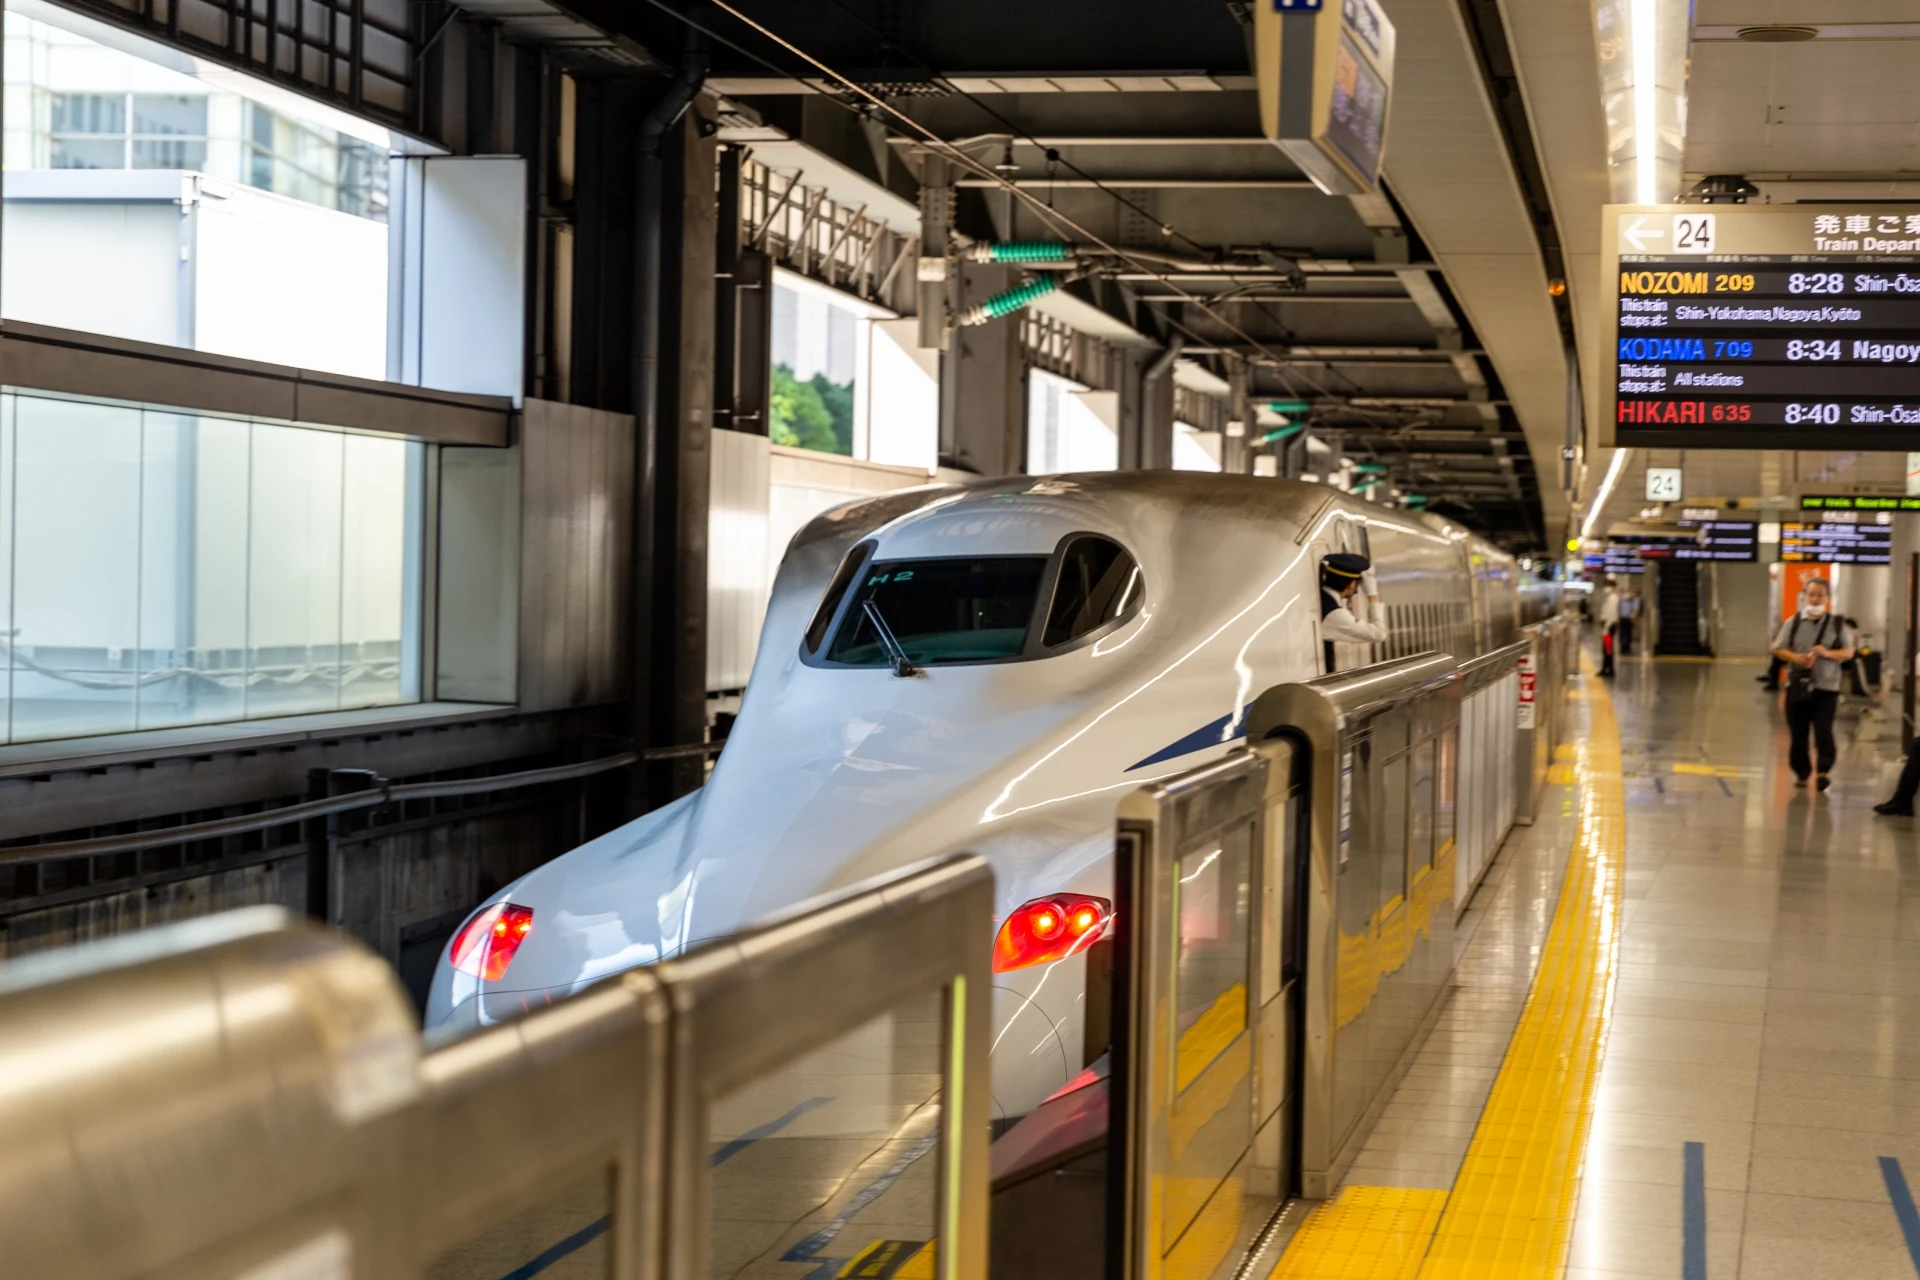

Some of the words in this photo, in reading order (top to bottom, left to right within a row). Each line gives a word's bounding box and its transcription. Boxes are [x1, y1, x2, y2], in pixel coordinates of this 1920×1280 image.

[1677, 219, 1711, 248] 24
[1813, 237, 1859, 251] Train
[1620, 271, 1709, 295] NOZOMI
[1715, 274, 1755, 292] 209
[1788, 272, 1845, 294] 8:28
[1619, 338, 1706, 360] KODAMA
[1713, 341, 1753, 358] 709
[1786, 339, 1842, 361] 8:34
[1673, 372, 1693, 386] All
[1693, 372, 1744, 386] stations
[1617, 401, 1705, 424] HIKARI
[1711, 404, 1751, 422] 635
[1784, 403, 1841, 424] 8:40
[1652, 475, 1674, 495] 24
